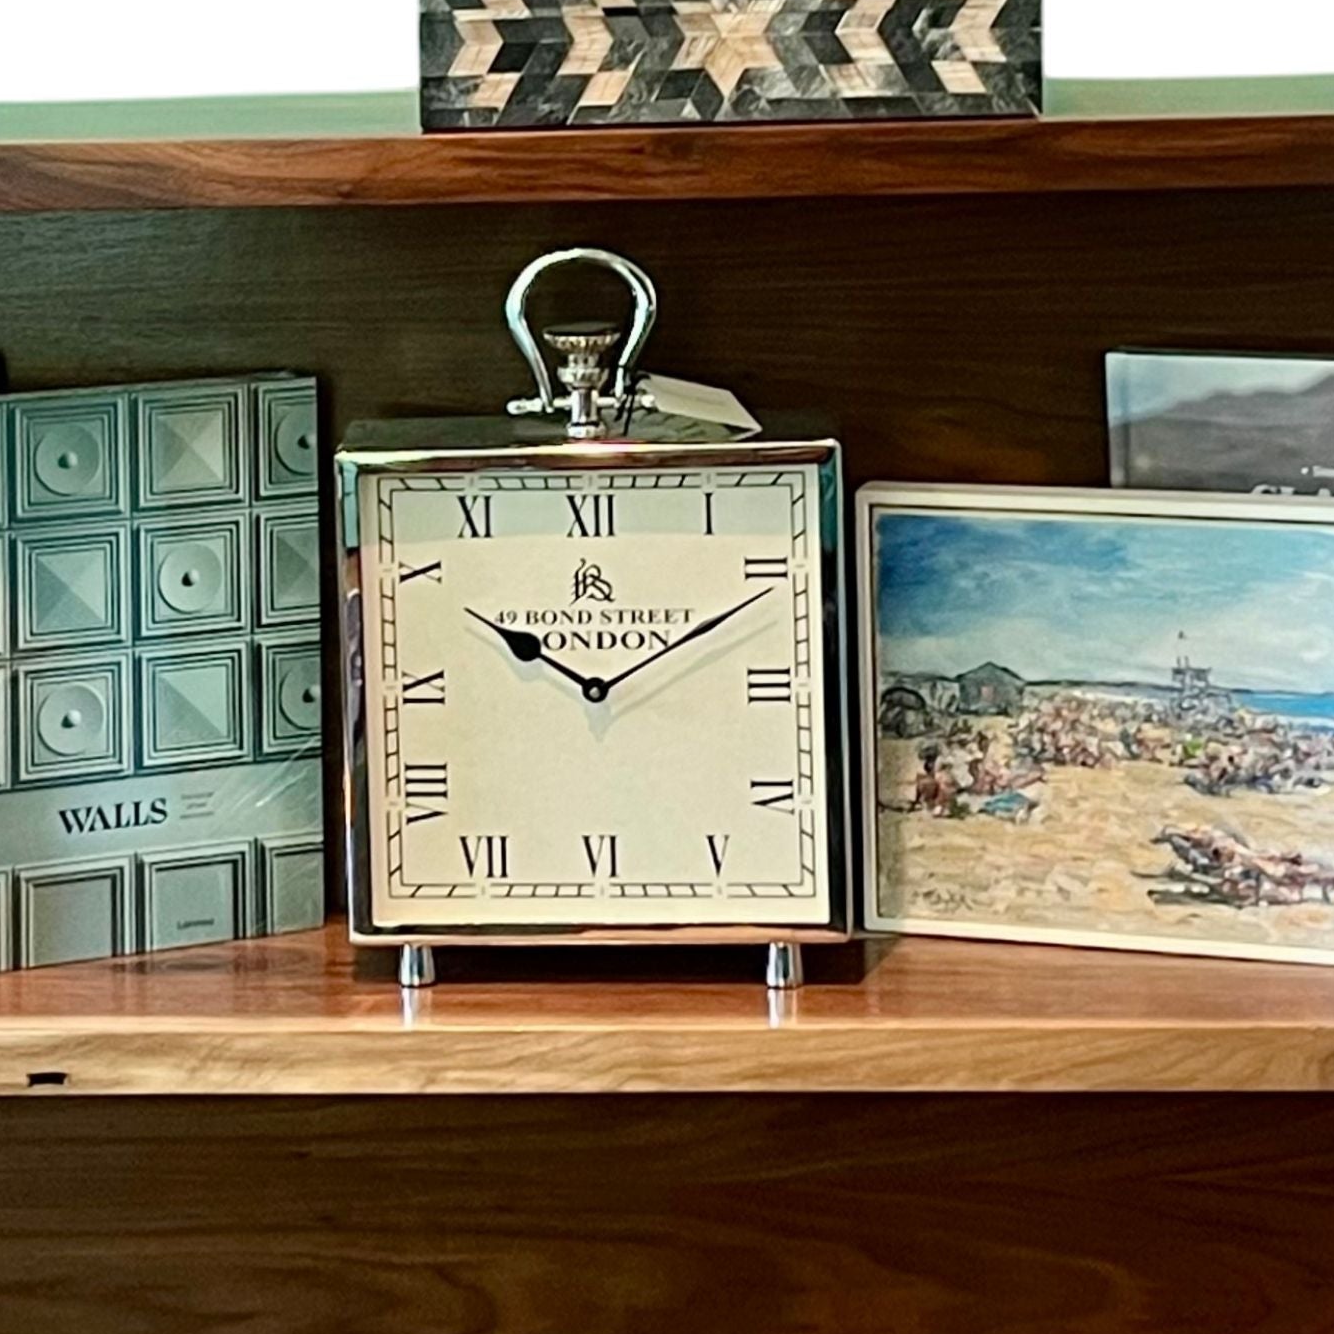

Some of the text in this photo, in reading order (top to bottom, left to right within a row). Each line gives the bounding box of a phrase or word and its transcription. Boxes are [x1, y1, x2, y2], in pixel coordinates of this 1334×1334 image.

[458, 495, 492, 539] XI
[566, 494, 615, 538] XII
[704, 492, 713, 535] I
[398, 561, 442, 584] X
[744, 557, 789, 580] II
[496, 608, 695, 626] 49 BOND STREET
[541, 630, 671, 652] ONDON
[402, 670, 445, 704] IX
[747, 668, 792, 703] III
[405, 763, 447, 823] VIII
[750, 780, 795, 815] IV
[58, 797, 169, 835] WALLS
[459, 835, 508, 879] VII
[582, 835, 617, 878] VI
[706, 834, 729, 875] V
